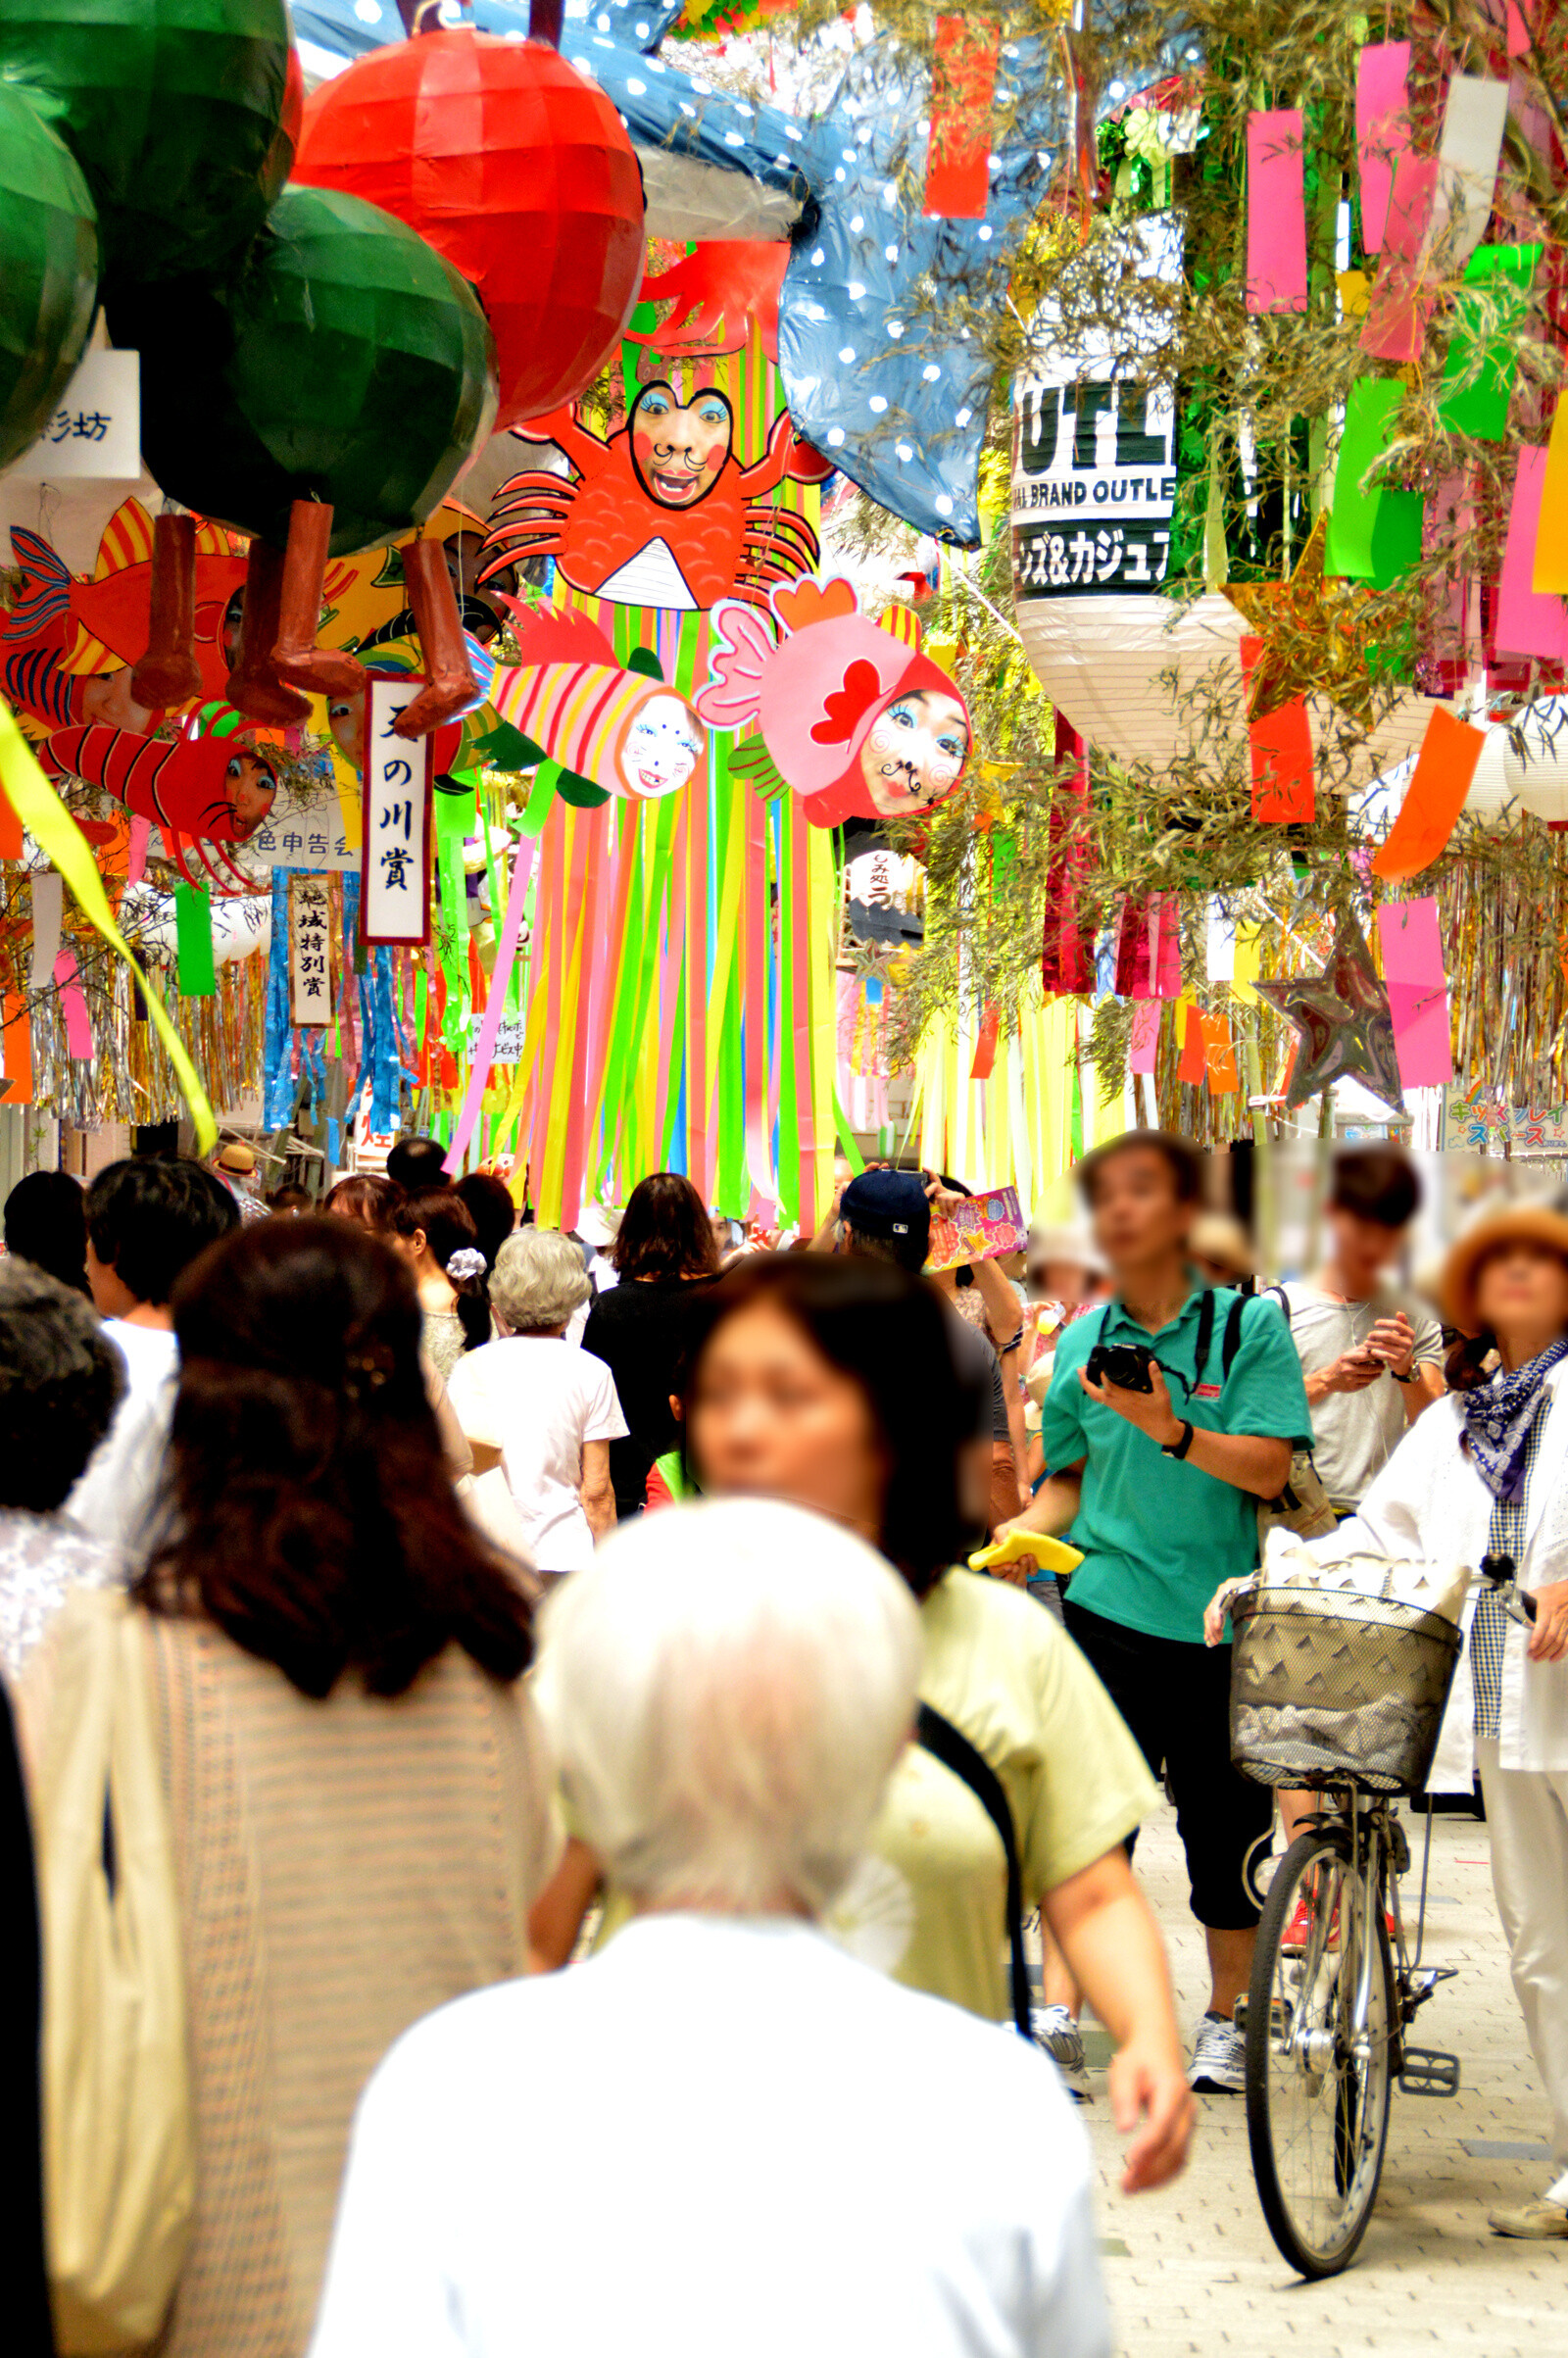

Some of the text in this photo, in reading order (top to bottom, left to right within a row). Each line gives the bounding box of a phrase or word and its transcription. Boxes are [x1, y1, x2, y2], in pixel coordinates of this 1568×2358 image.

[1022, 379, 1176, 475] UTL
[1030, 481, 1088, 508] BRAND
[378, 705, 415, 892] 天の川賞
